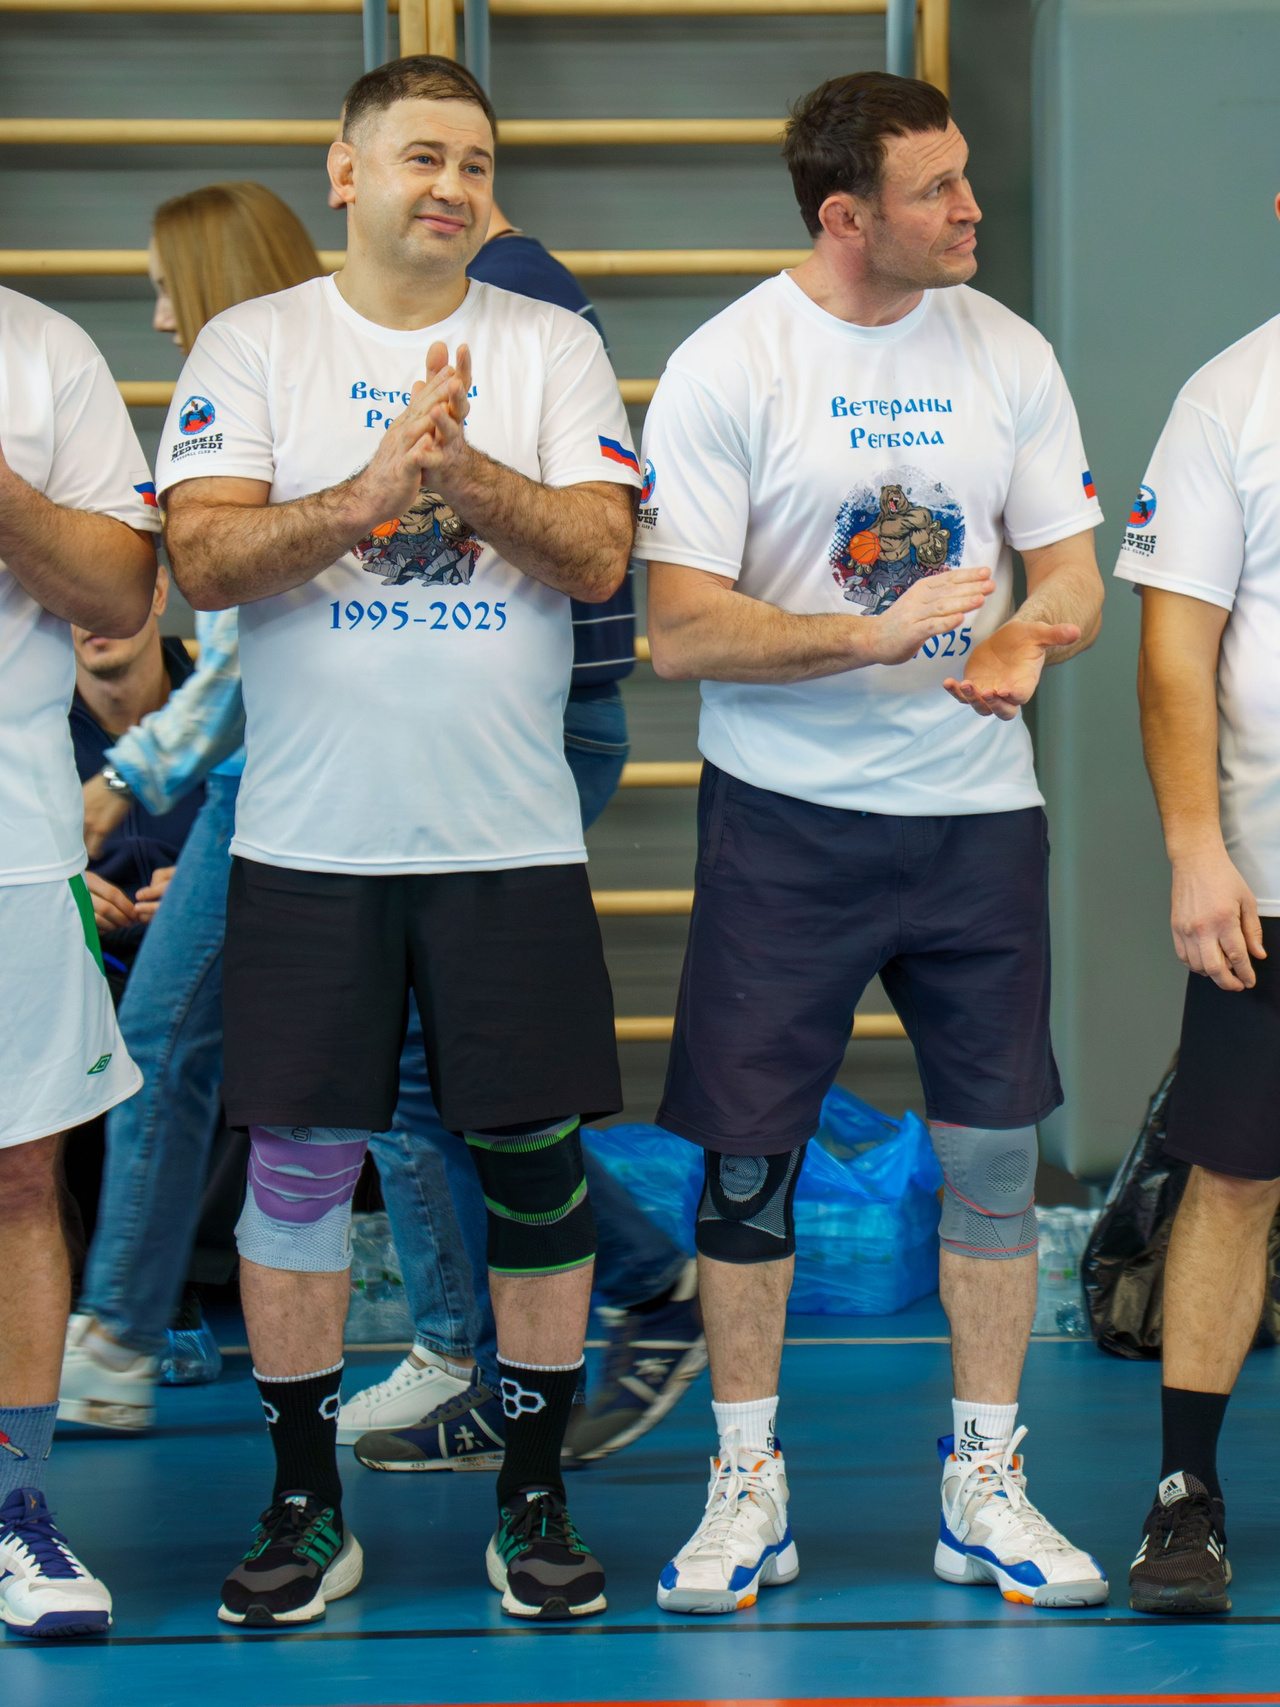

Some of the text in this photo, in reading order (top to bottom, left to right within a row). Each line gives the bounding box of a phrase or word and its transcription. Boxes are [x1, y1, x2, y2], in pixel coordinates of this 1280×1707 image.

[831, 395, 953, 422] Ветераны
[172, 432, 224, 453] RUSSKIE
[849, 427, 945, 449] Регбола
[171, 442, 223, 462] MEDVEDI
[329, 600, 508, 632] 1995-2025
[959, 1438, 990, 1452] RSL
